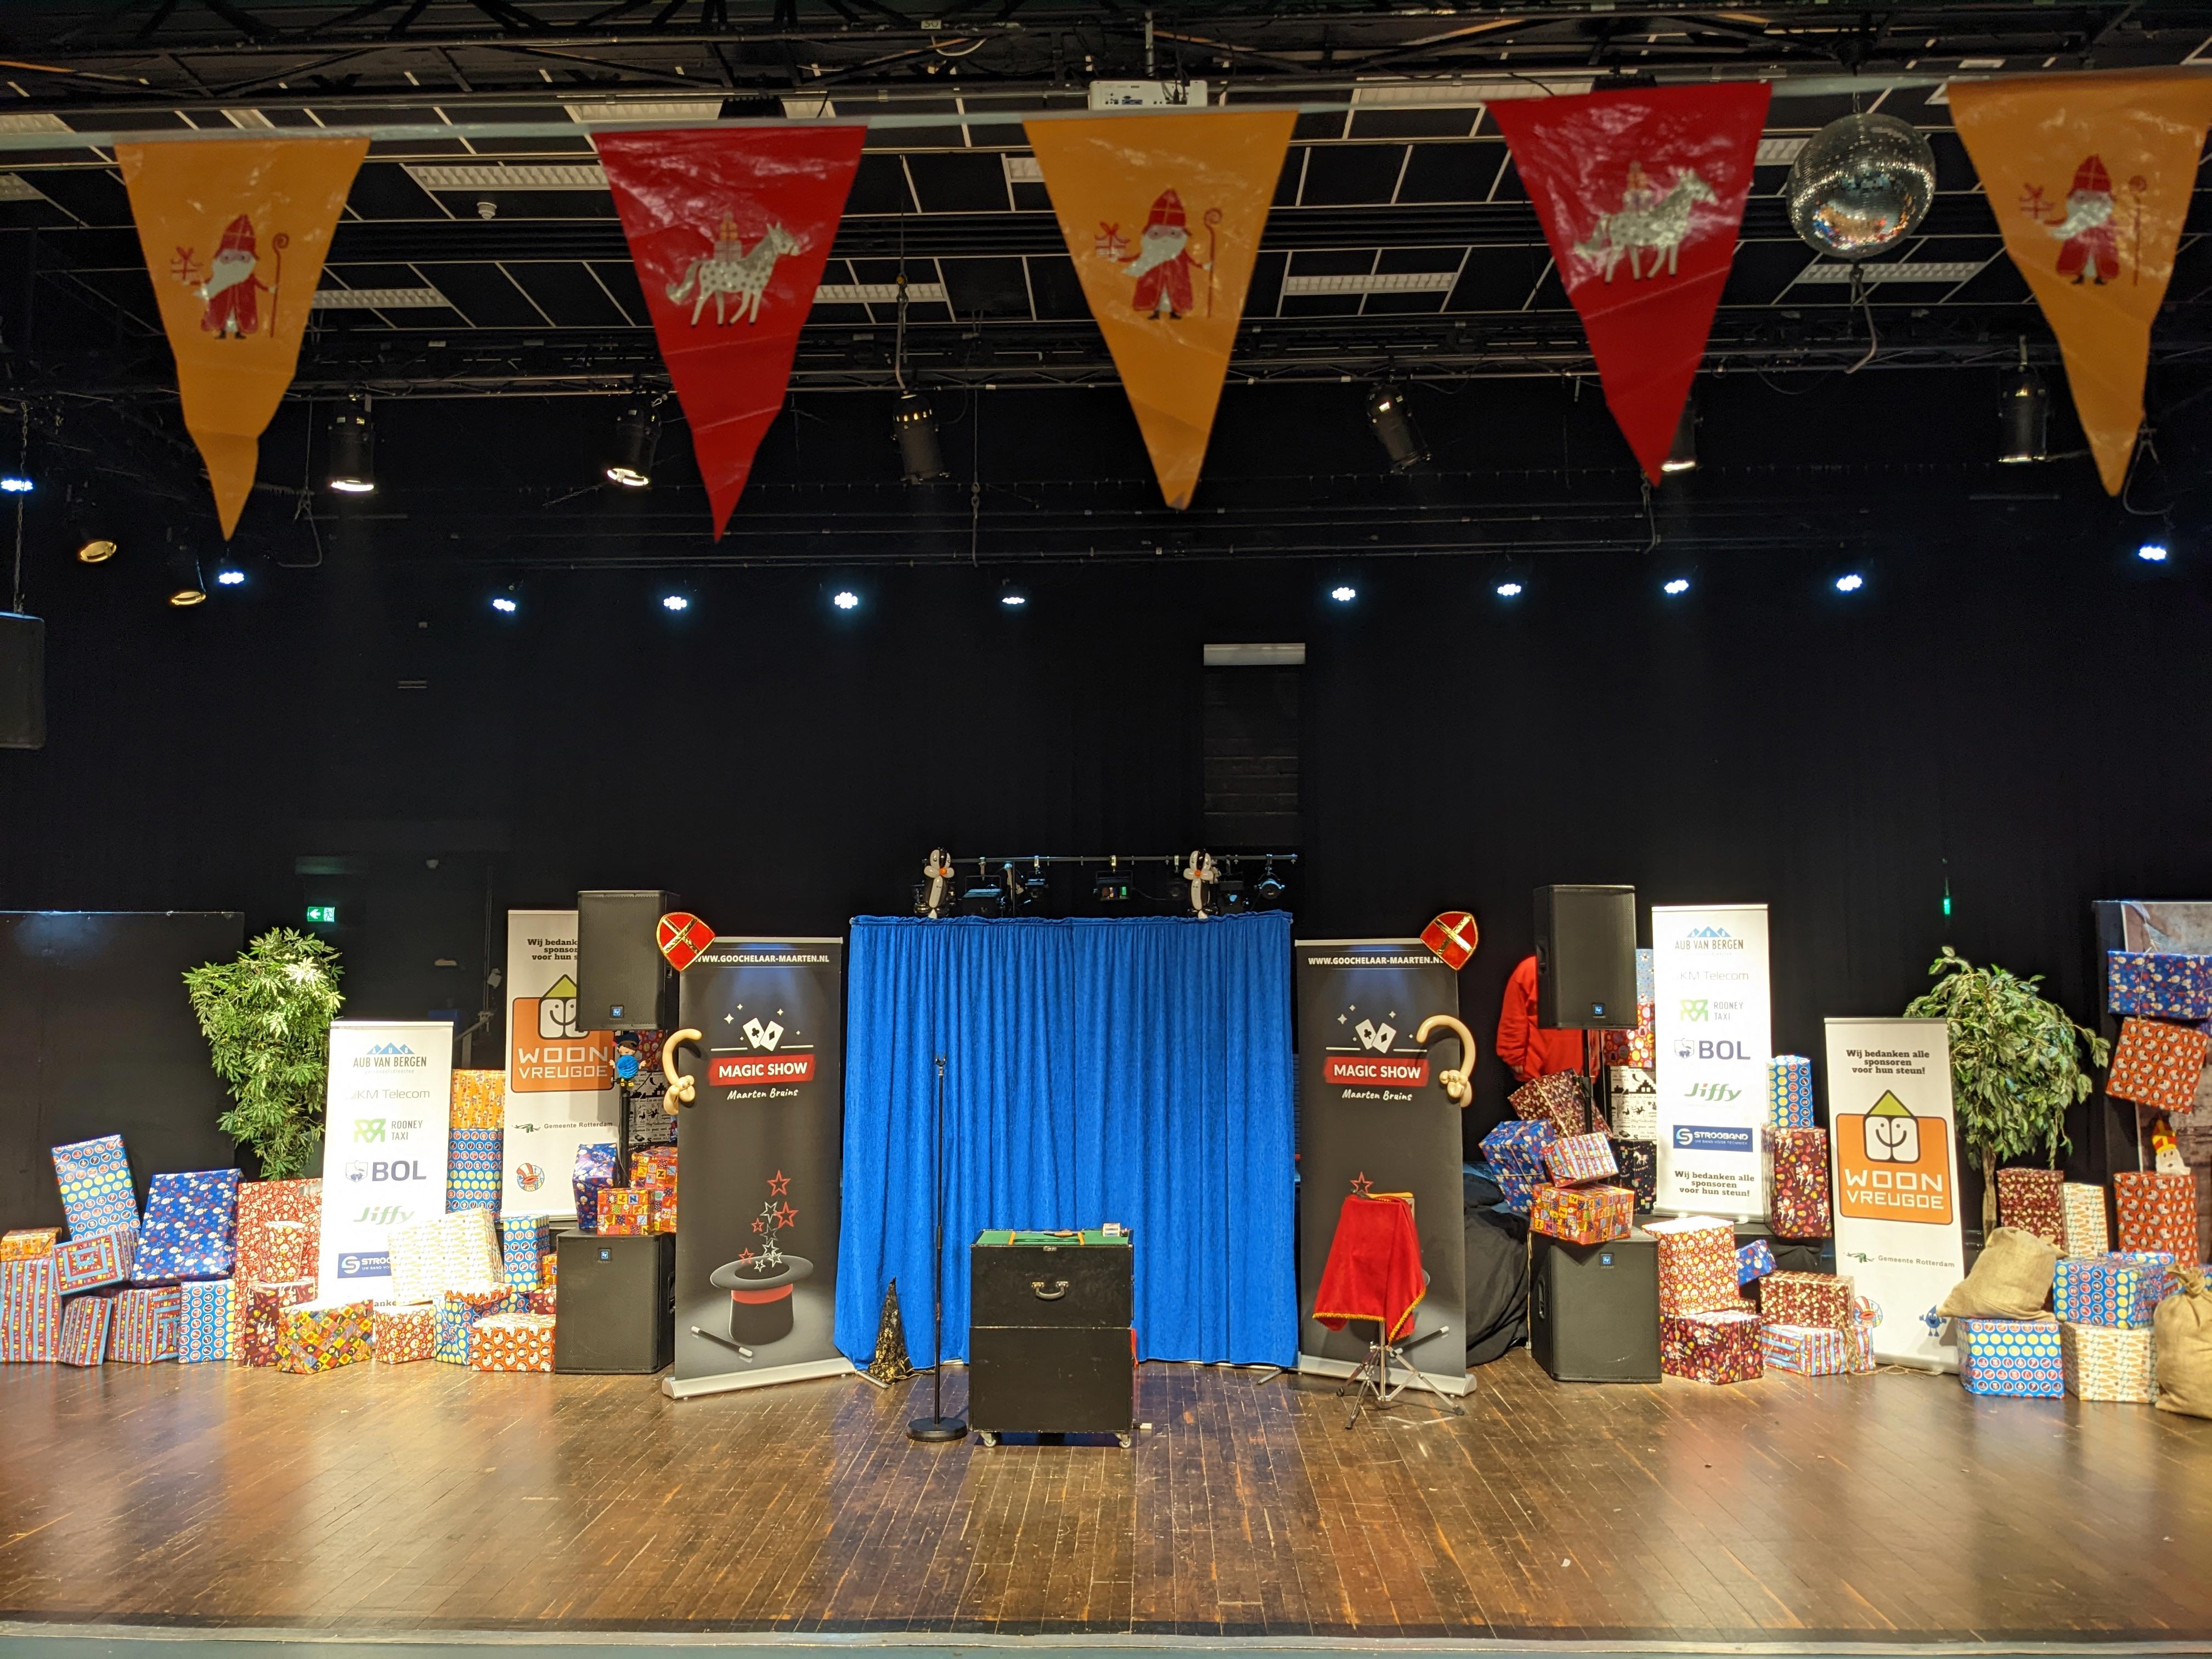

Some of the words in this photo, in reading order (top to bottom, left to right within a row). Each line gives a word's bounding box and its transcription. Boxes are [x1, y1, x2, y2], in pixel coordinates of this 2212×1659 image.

[527, 939, 543, 947] Wij
[1675, 940, 1690, 950] AUB
[1694, 940, 1708, 950] VAN
[1712, 939, 1743, 950] BERGEN
[1703, 971, 1748, 980] Telecom
[518, 1046, 608, 1064] WOON
[1699, 1040, 1751, 1060] BOL
[1846, 1049, 1863, 1059] Wij
[1865, 1049, 1910, 1058] bedanken
[1912, 1050, 1929, 1058] alle
[353, 1057, 370, 1068] AUB
[374, 1057, 390, 1067] VAN
[394, 1056, 427, 1067] BERGEN
[1864, 1058, 1912, 1067] sponsoren
[719, 1064, 764, 1078] MAGIC
[768, 1062, 808, 1075] SHOW
[1334, 1064, 1376, 1077] MAGIC
[1380, 1065, 1421, 1079] SHOW
[1896, 1066, 1926, 1075] steun!
[357, 1090, 379, 1099] KM
[382, 1089, 430, 1099] Telecom
[727, 1090, 766, 1100] Maarten
[770, 1088, 798, 1098] Bruins
[1341, 1089, 1380, 1099] Maarten
[1383, 1090, 1413, 1101] Bruins
[1684, 1083, 1742, 1102] Jiffy
[391, 1120, 423, 1129] ROONEY
[391, 1132, 409, 1141] TAXI
[1694, 1131, 1748, 1140] STROOBAND
[372, 1160, 427, 1182] BOL
[1674, 1170, 1690, 1179] Wij
[1692, 1171, 1735, 1181] bedanken
[1691, 1180, 1737, 1188] sponsoren
[1844, 1169, 1943, 1192] WOON
[1722, 1189, 1750, 1197] steun!
[353, 1206, 415, 1225] Jiffy
[362, 1257, 391, 1265] STROO
[1878, 1255, 1914, 1264] Gemeente
[1916, 1258, 1955, 1268] Rotterdam
